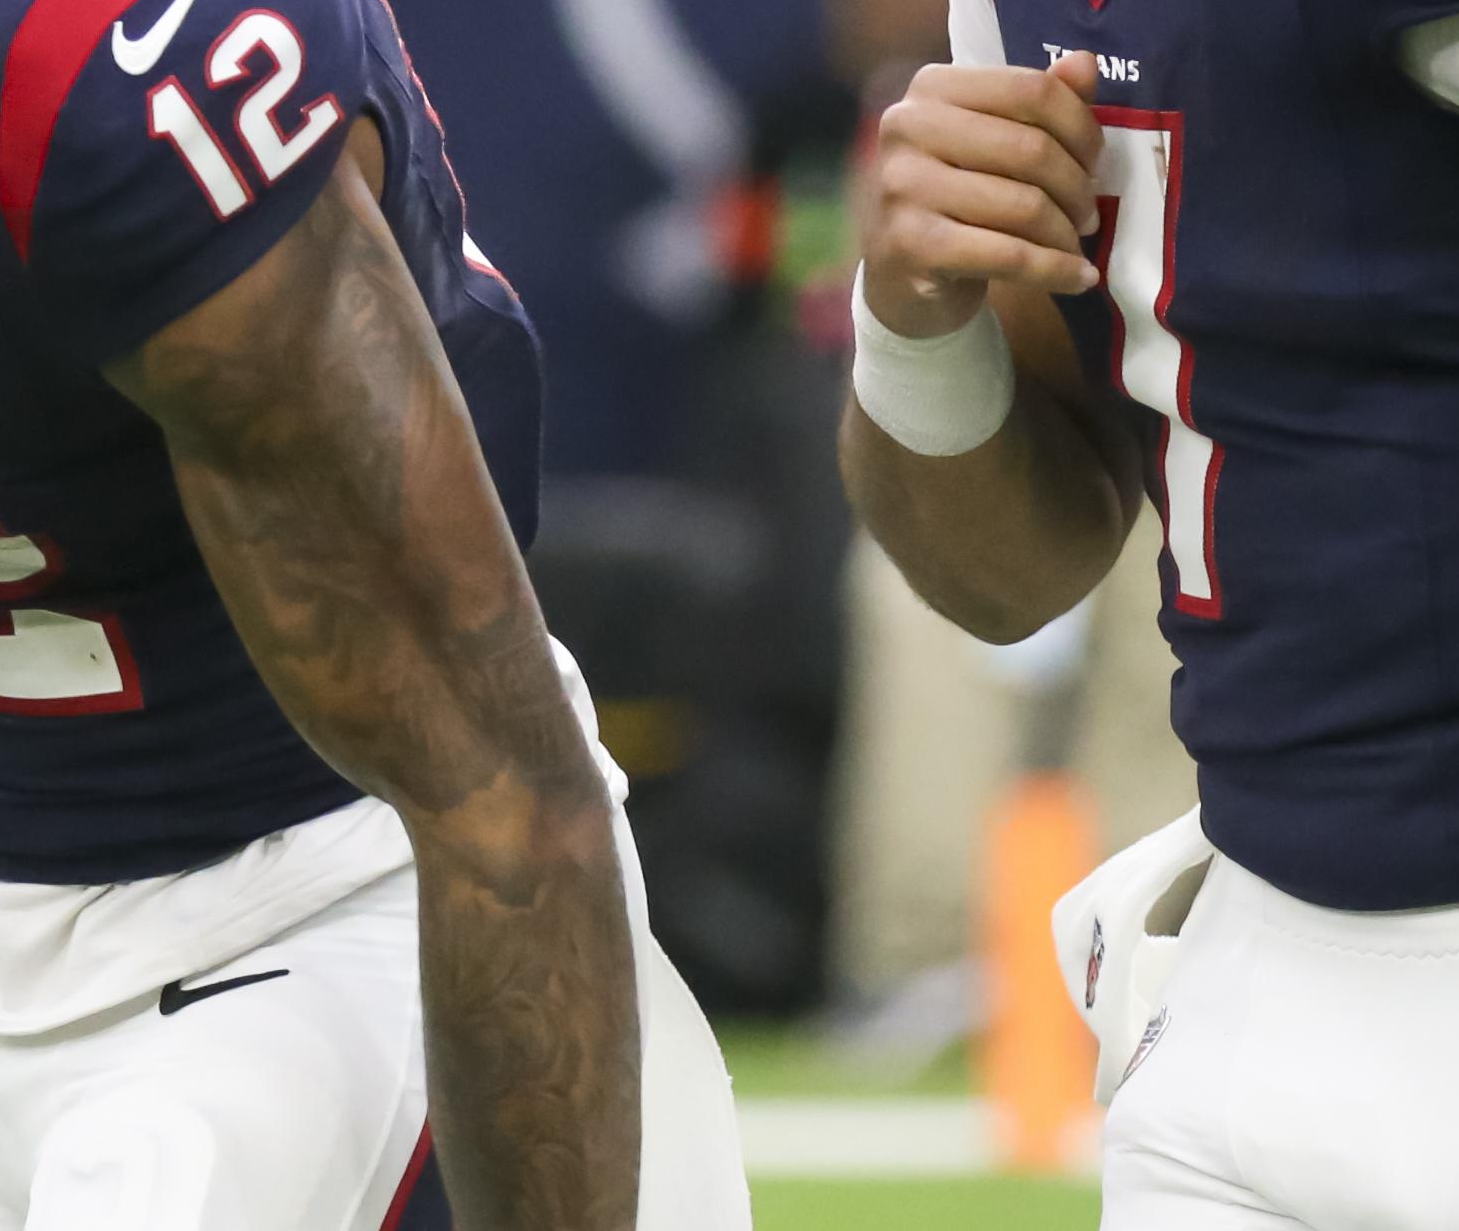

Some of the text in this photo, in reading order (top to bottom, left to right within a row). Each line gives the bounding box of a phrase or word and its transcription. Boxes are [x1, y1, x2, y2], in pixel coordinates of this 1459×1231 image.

[146, 8, 344, 222] 12
[1042, 42, 1140, 82] TANS
[1091, 104, 1227, 620] 7
